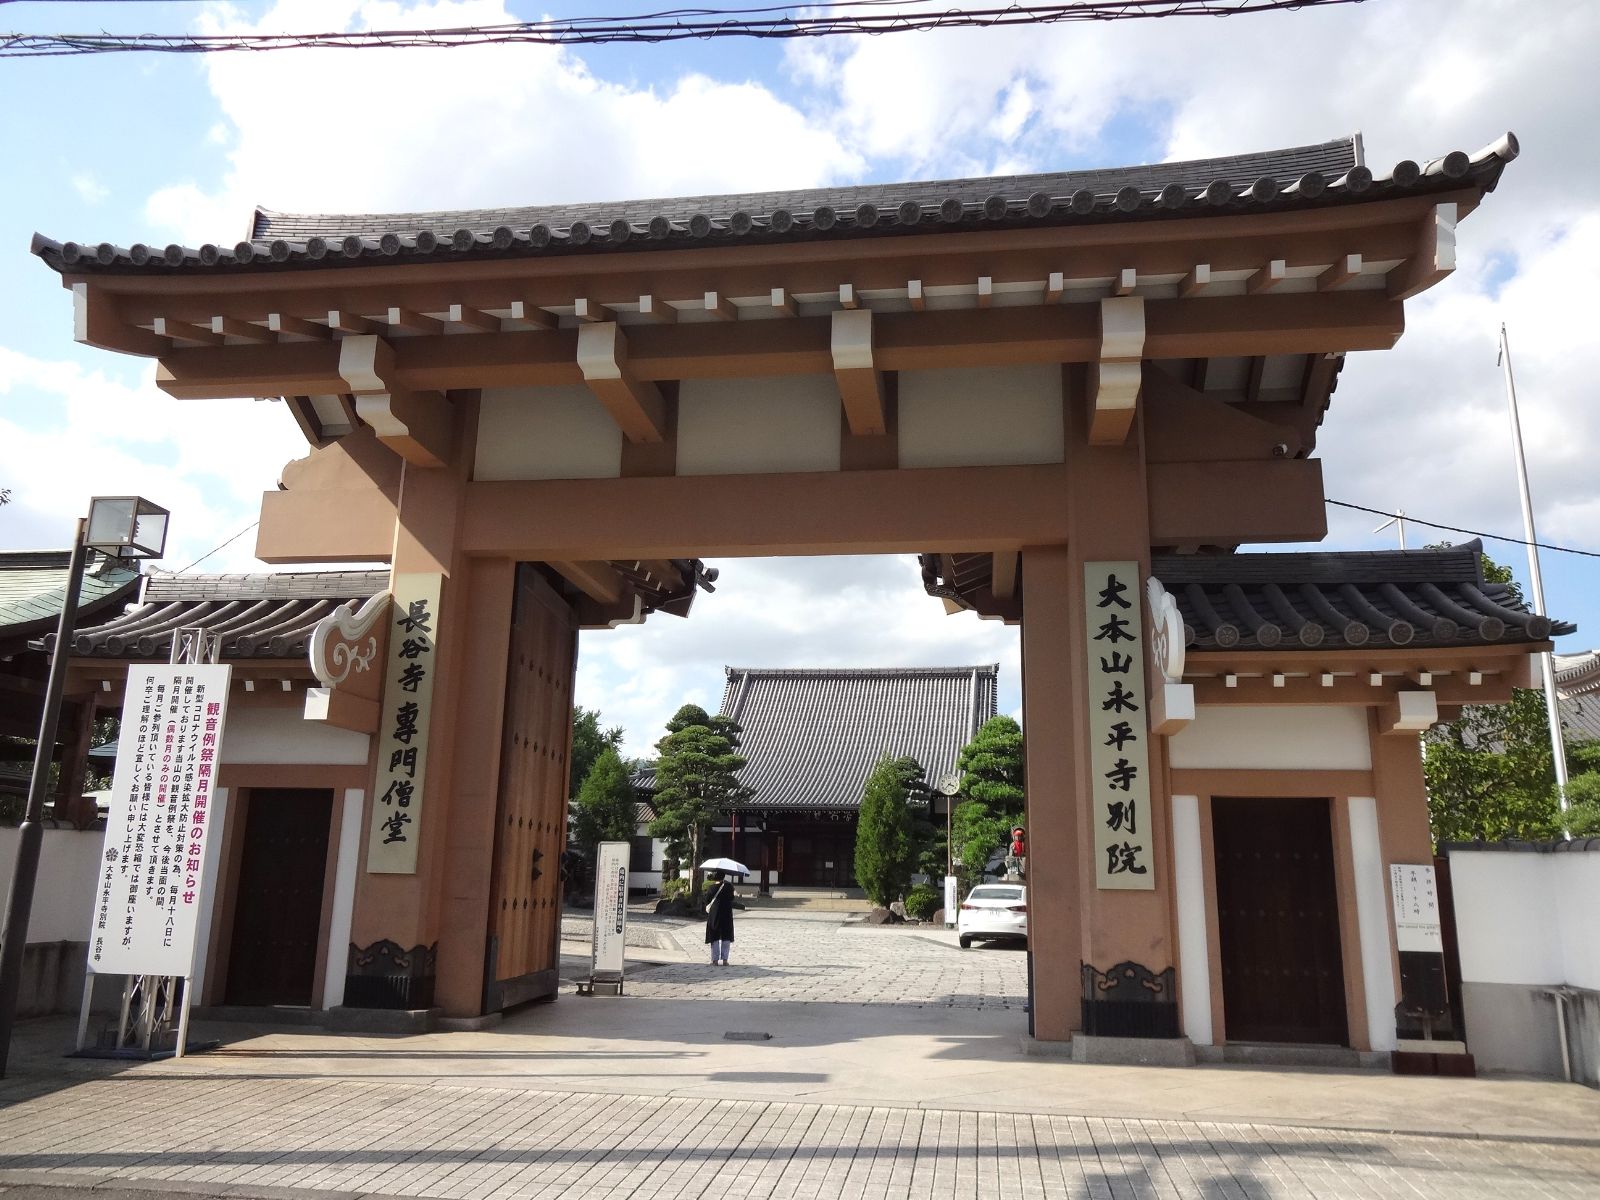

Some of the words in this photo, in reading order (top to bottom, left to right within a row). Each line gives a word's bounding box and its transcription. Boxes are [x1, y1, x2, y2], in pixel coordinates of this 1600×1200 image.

[1093, 574, 1147, 875] 大本山永平寺別院
[182, 702, 220, 904] 観音例祭隔月開催のお知らせ
[94, 937, 103, 961] 長谷寺
[98, 865, 113, 929] 大本山永平寺別院
